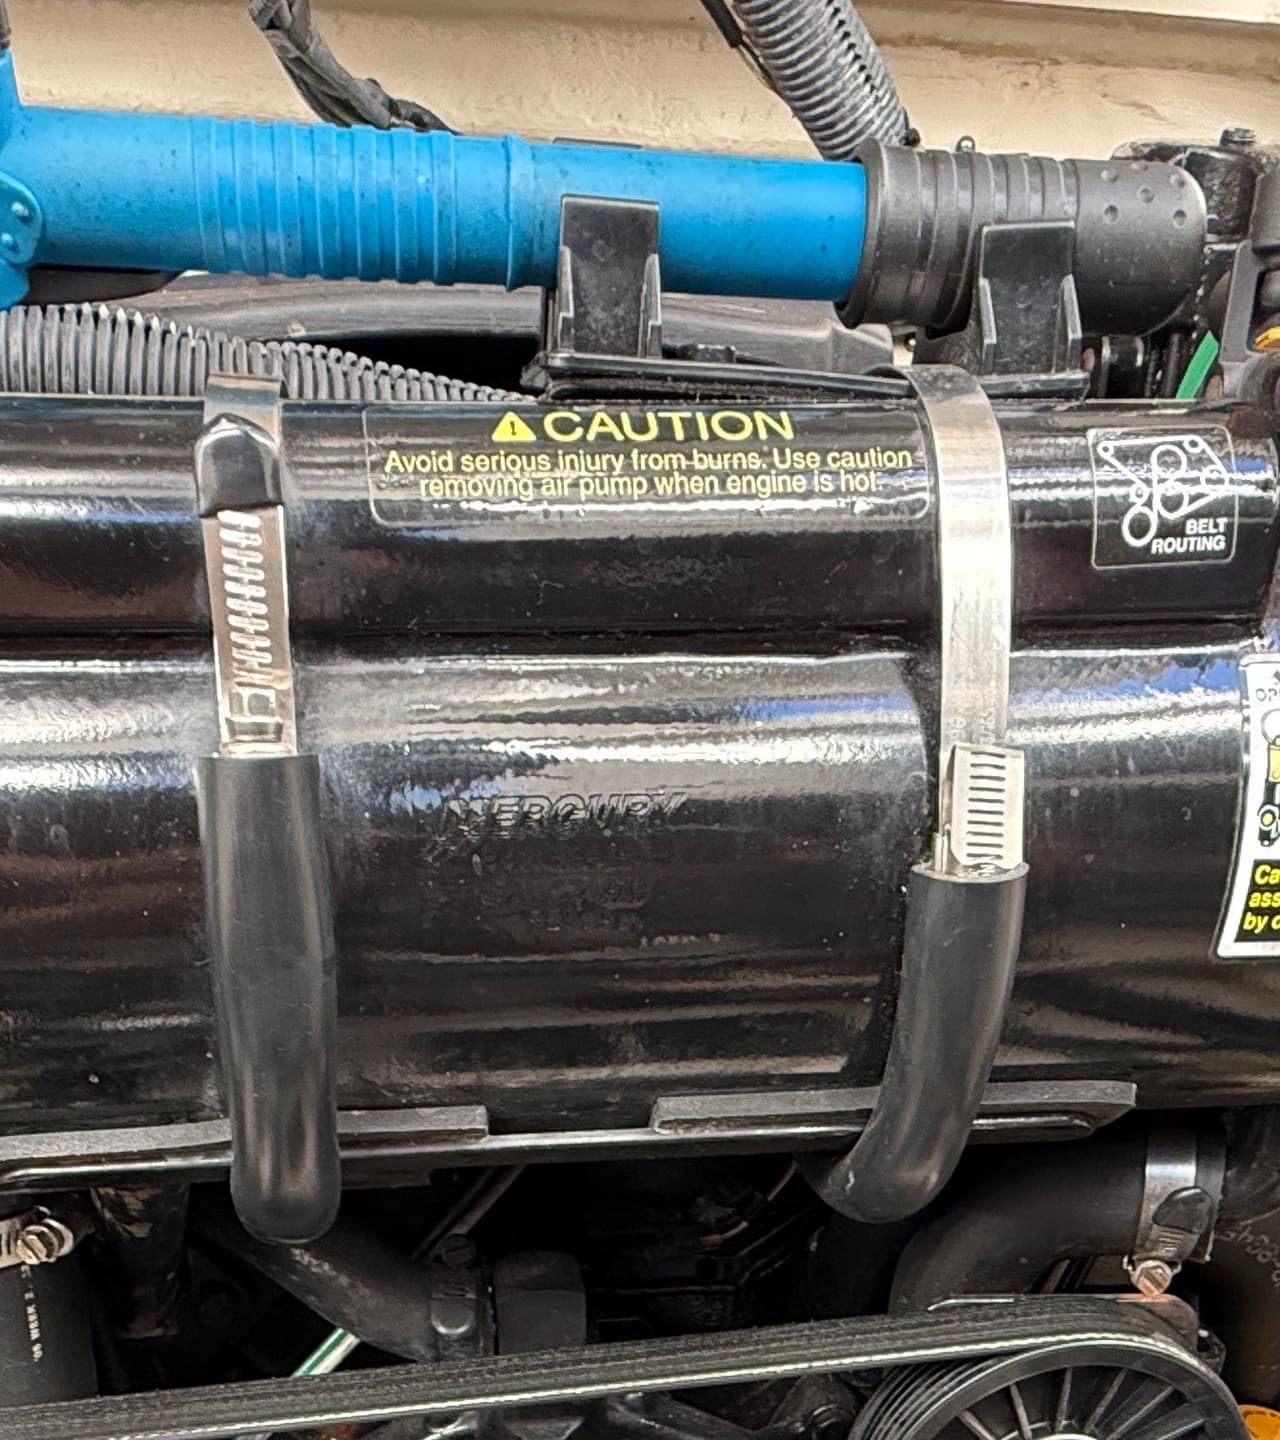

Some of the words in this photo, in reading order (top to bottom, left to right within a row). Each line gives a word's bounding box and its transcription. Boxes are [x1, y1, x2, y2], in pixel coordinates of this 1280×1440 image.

[543, 410, 795, 442] CAUTION
[384, 449, 454, 473] Avoid
[460, 451, 551, 472] serious
[558, 450, 625, 475] injury
[630, 448, 687, 471] from
[692, 448, 768, 470] burns.
[772, 447, 821, 470] Use
[826, 446, 913, 469] caution
[419, 477, 534, 501] removing
[541, 476, 570, 497] air
[579, 478, 648, 501] pump
[653, 473, 719, 495] when
[726, 471, 807, 498] engine
[813, 470, 833, 493] is
[839, 469, 884, 493] hot.
[1185, 517, 1228, 535] BELT
[1150, 535, 1227, 554] ROUTING
[1242, 913, 1270, 934] by
